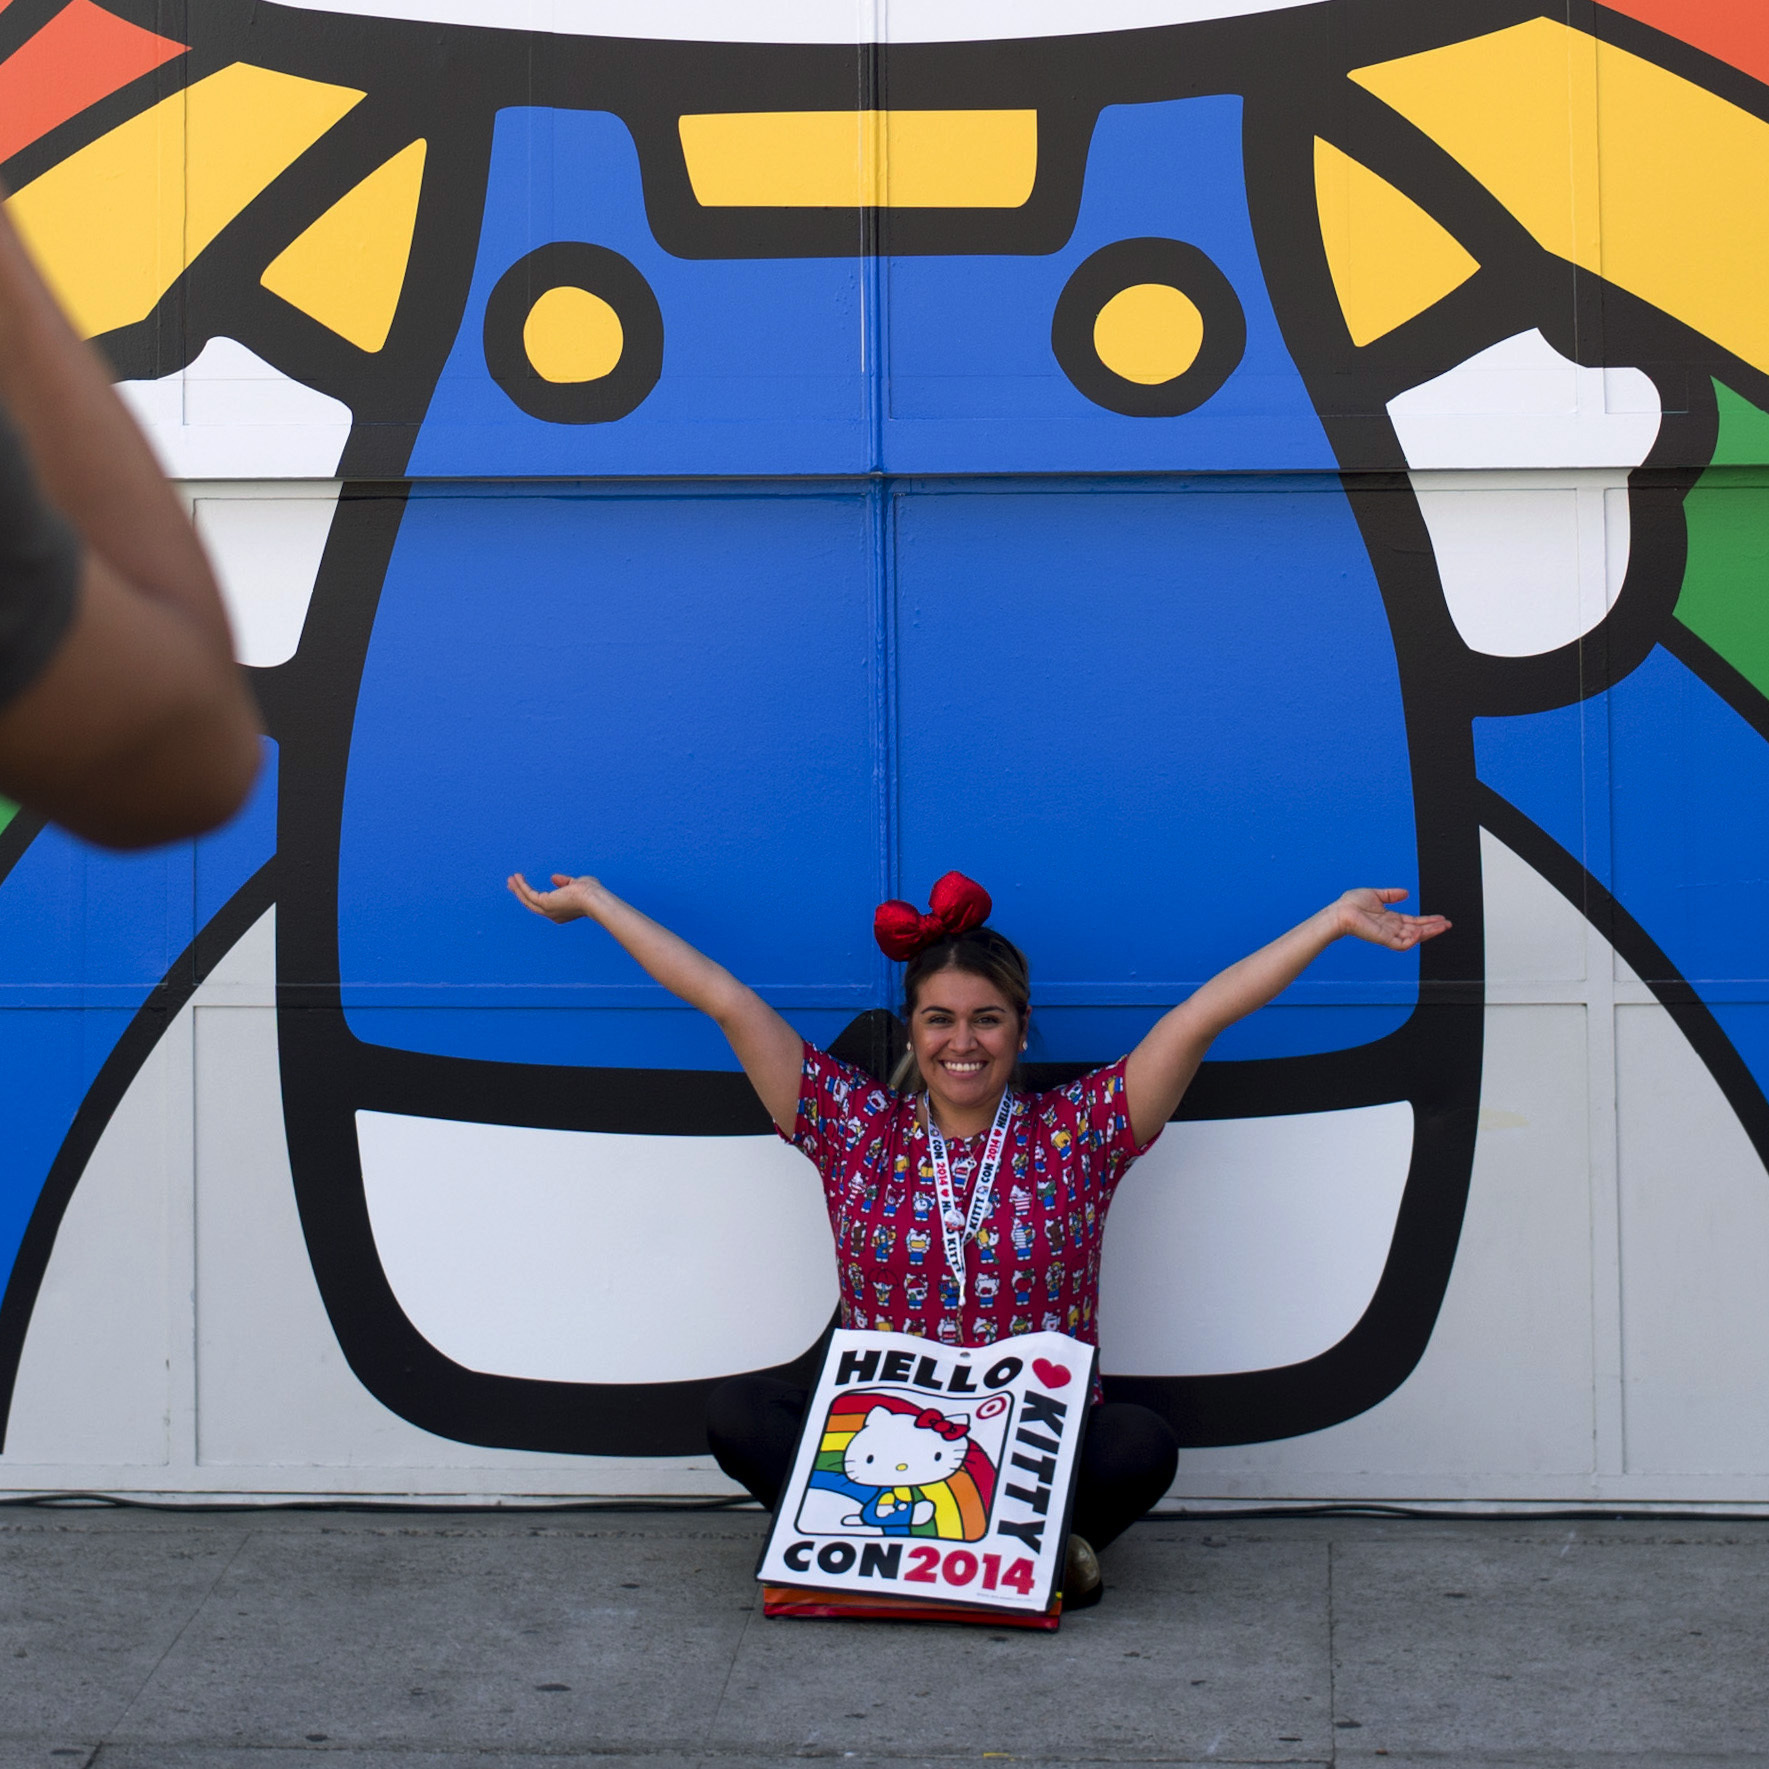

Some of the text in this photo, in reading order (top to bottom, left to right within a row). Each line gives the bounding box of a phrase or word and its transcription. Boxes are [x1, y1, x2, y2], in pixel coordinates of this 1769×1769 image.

[996, 1100, 1011, 1129] HELLO
[933, 1139, 944, 1160] CON
[987, 1139, 1001, 1161] 2014
[937, 1162, 948, 1185] 2014
[981, 1163, 994, 1183] CON
[969, 1196, 984, 1230] KITTY
[835, 1350, 1023, 1392] HELLO
[997, 1390, 1068, 1555] KITTY
